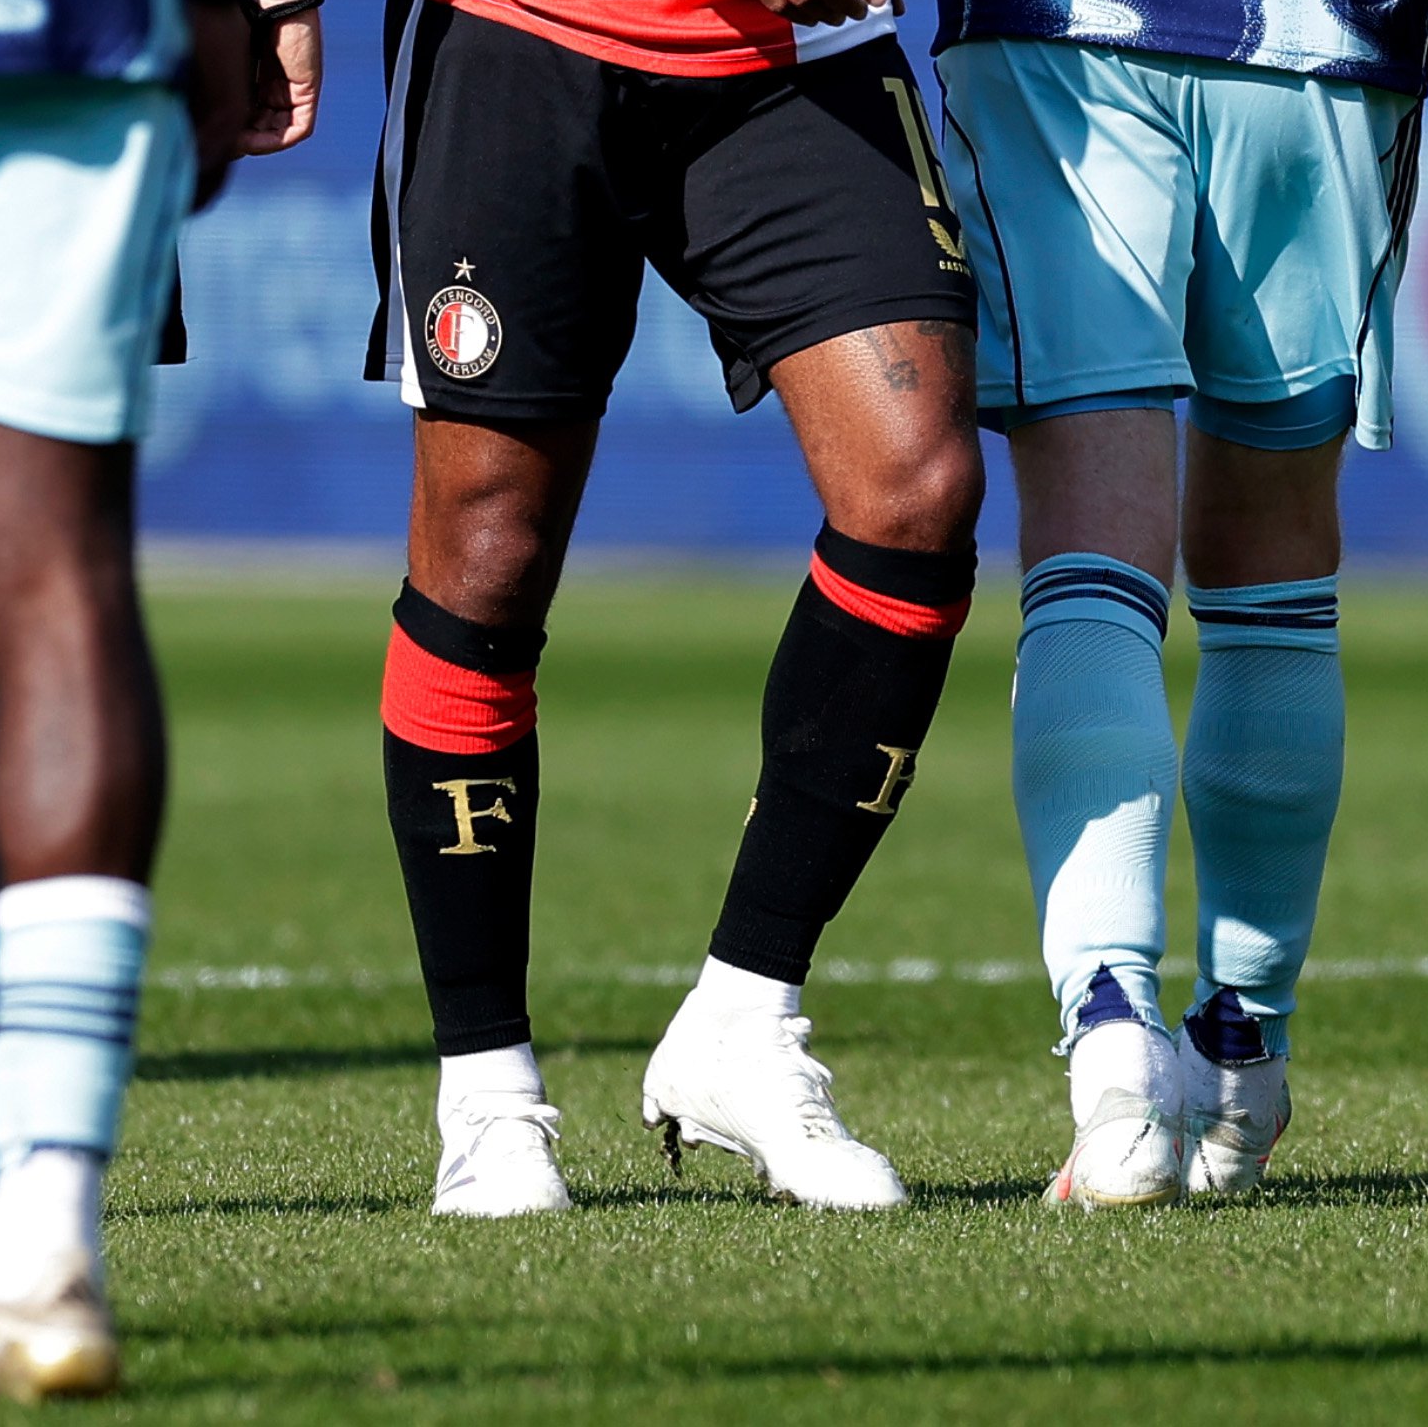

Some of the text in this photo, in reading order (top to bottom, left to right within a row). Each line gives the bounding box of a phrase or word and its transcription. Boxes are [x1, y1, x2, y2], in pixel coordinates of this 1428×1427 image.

[431, 290, 496, 325] FEYENOORD
[427, 338, 495, 375] ROTTERDAM
[432, 776, 517, 855] F
